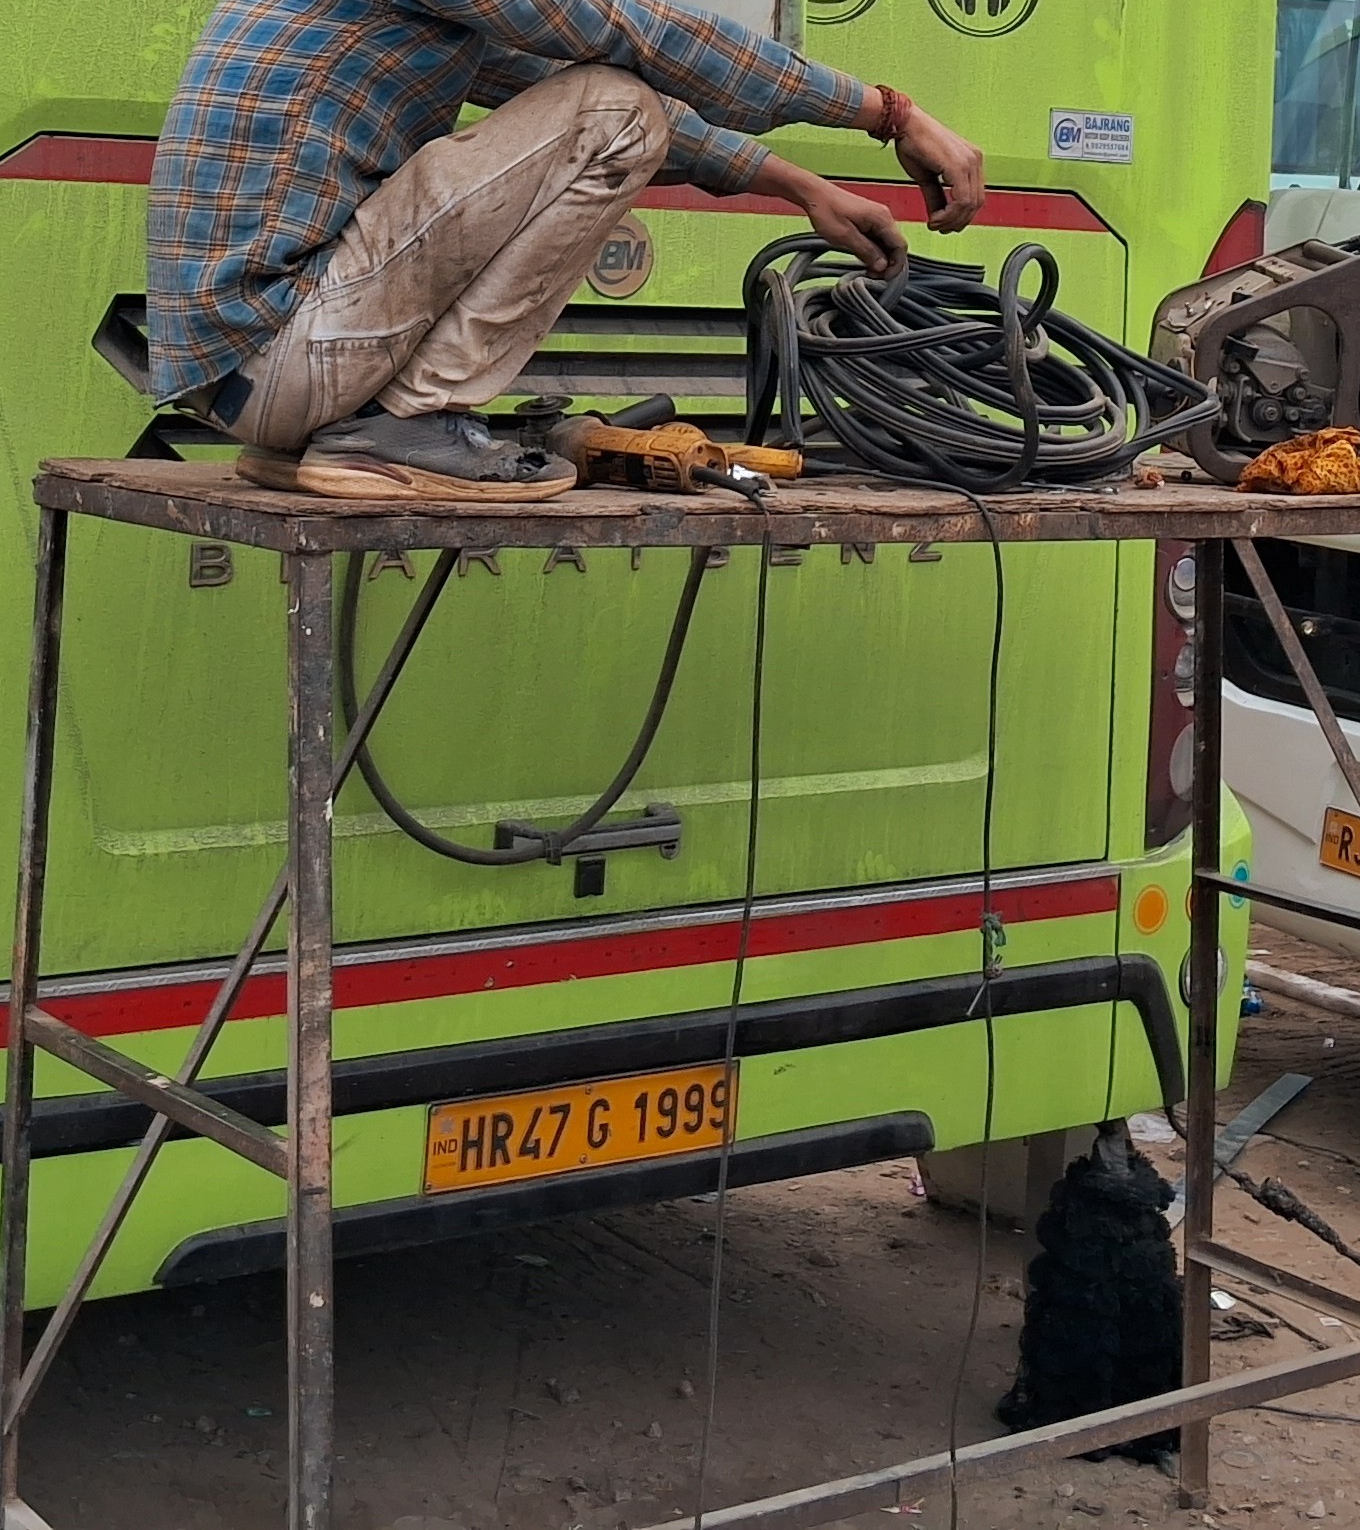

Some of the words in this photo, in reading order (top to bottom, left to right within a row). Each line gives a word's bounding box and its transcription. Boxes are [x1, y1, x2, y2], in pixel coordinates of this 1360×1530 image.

[1085, 116, 1130, 133] BAJRANG
[432, 1138, 458, 1156] IND
[459, 1102, 572, 1173] HR47
[586, 1098, 611, 1150] G
[633, 1079, 728, 1144] 1999
